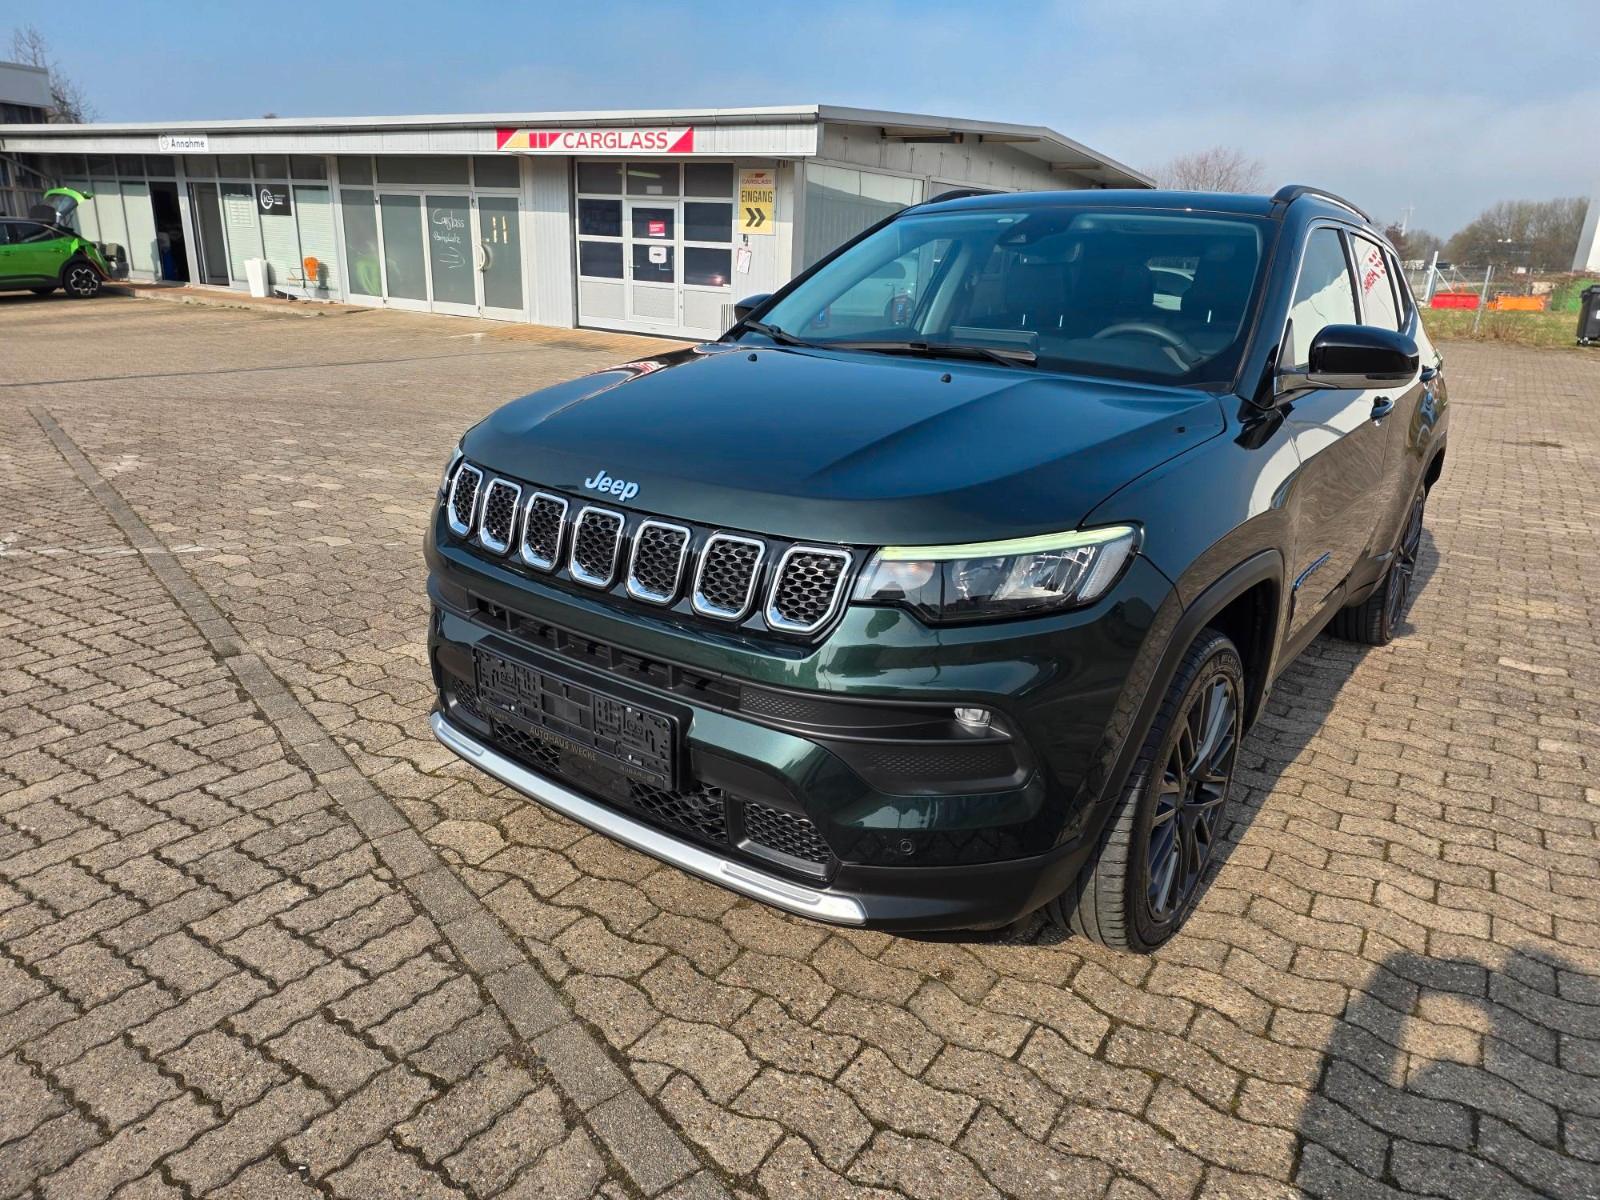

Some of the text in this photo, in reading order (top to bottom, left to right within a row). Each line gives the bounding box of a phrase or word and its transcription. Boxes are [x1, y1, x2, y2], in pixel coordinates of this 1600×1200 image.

[171, 137, 205, 148] Annahme
[563, 132, 668, 149] CARGLASS
[741, 190, 773, 203] EINGANG
[432, 208, 465, 230] Carglass
[584, 470, 639, 502] Jeep
[529, 726, 569, 749] AUTOHAUS
